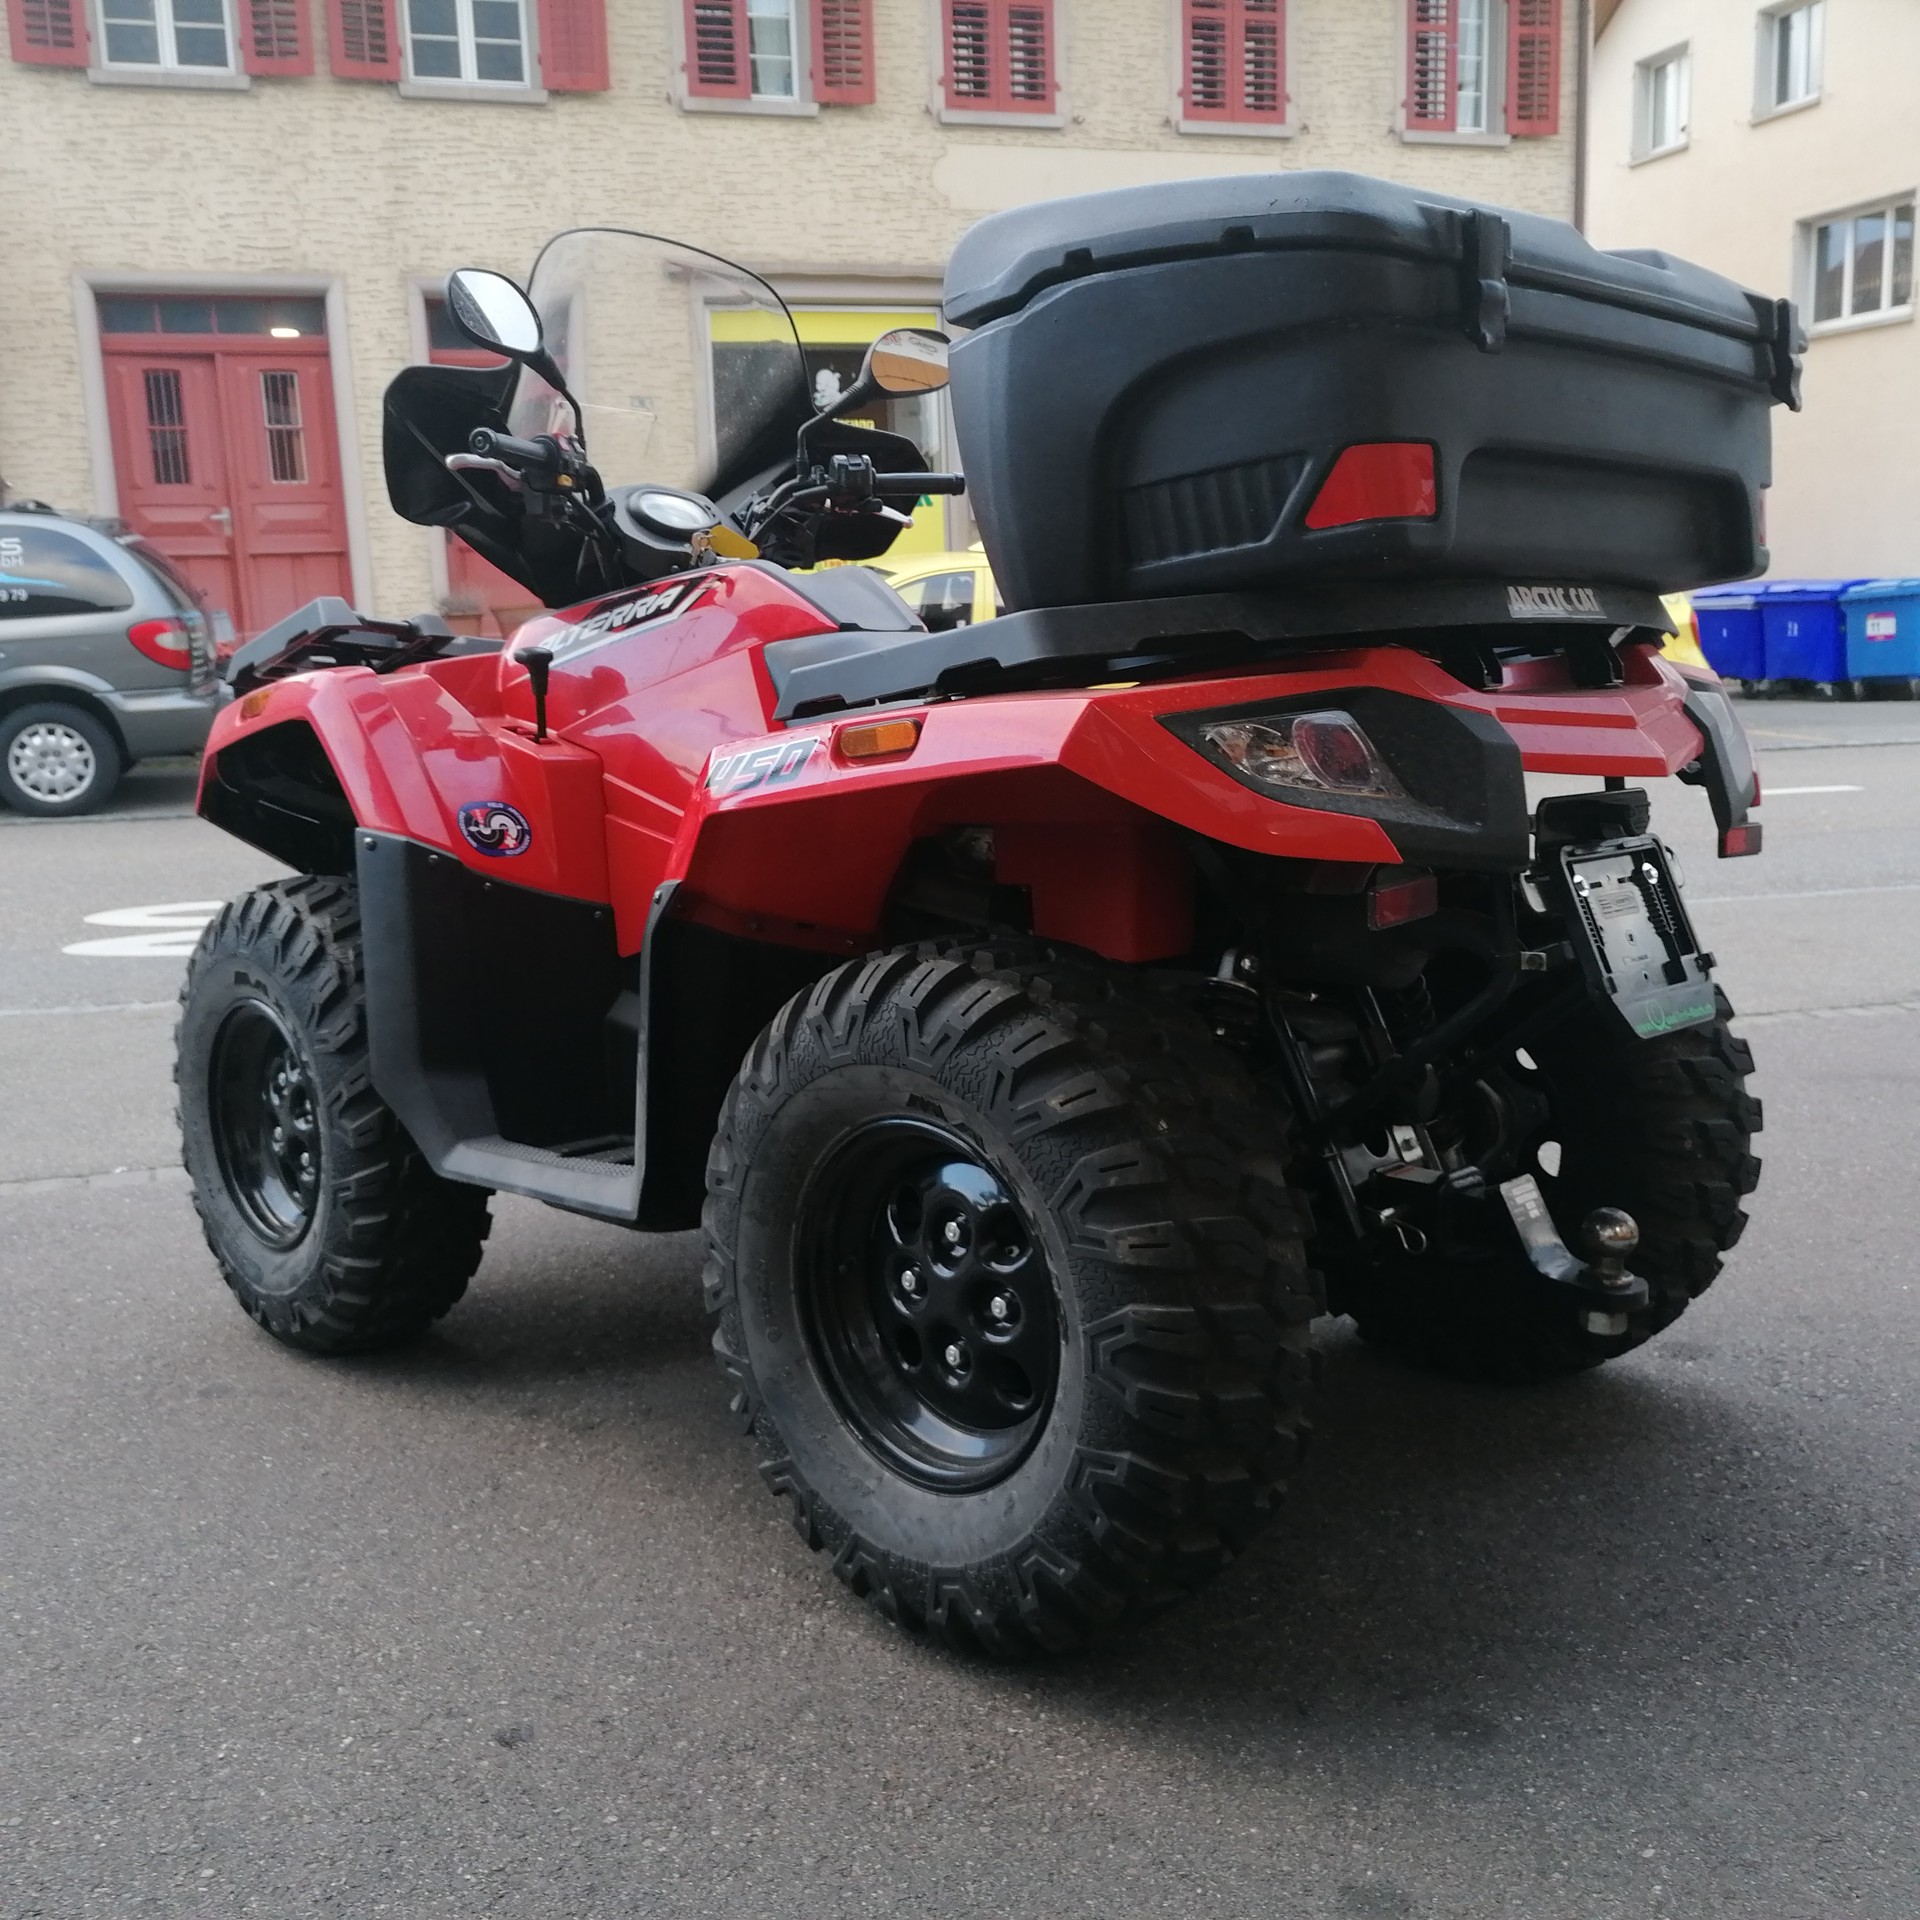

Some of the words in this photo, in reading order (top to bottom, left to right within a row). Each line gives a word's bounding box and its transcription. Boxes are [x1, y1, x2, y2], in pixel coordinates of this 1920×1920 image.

[537, 584, 686, 652] ALTERRA
[1507, 586, 1573, 611] ARCTIC
[1569, 587, 1600, 611] CAT
[703, 736, 821, 797] 450
